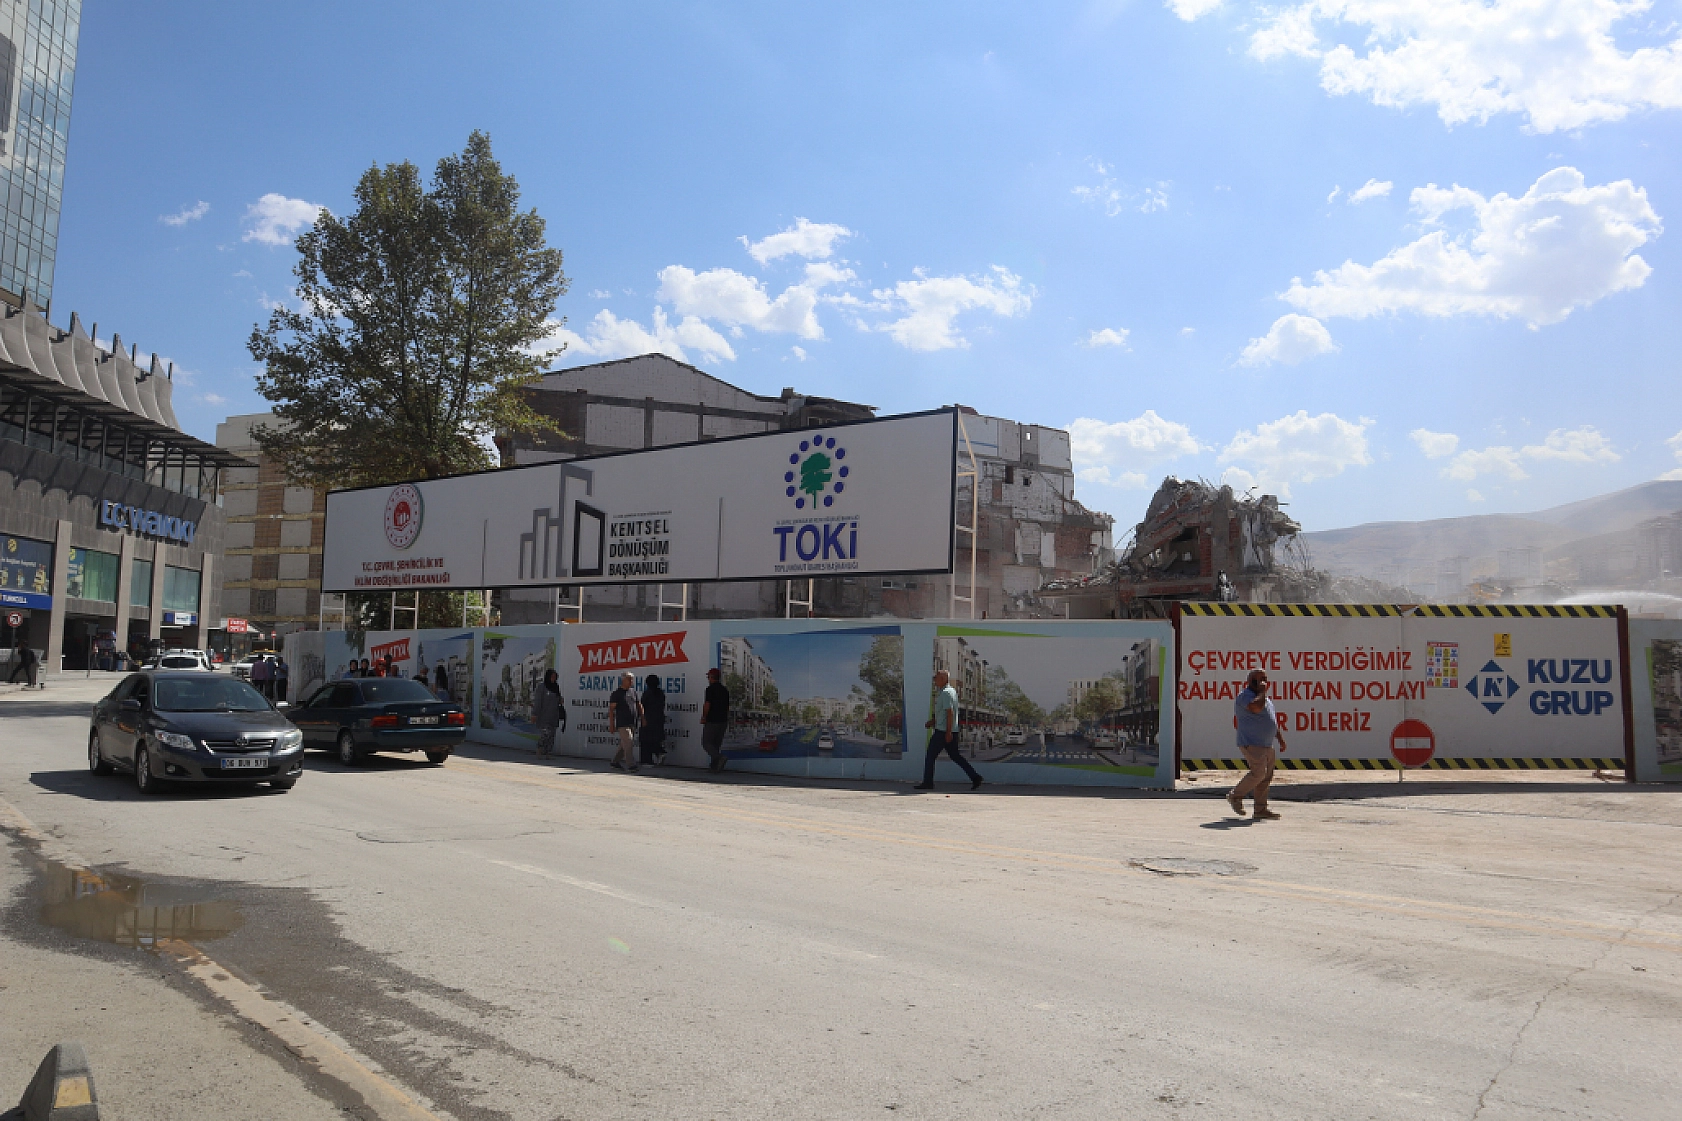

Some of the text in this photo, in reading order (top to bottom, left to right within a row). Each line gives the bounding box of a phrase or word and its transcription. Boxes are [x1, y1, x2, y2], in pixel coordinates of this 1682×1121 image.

[102, 499, 127, 528] LC
[611, 519, 670, 537] KENTSEL
[609, 537, 670, 560] DÖNÜŞÜM
[434, 557, 444, 568] VE
[608, 557, 669, 579] BAŞKANLIĞI
[587, 639, 677, 667] MALATYA
[1187, 650, 1281, 675] ÇEVREYE
[1288, 645, 1412, 671] VERDİĞİMİZ
[578, 674, 614, 692] SARAY
[1527, 659, 1612, 684] KUZU
[1350, 681, 1425, 701] DOLAYI
[1529, 690, 1614, 715] GRUP
[1295, 707, 1372, 732] DİLERİZ
